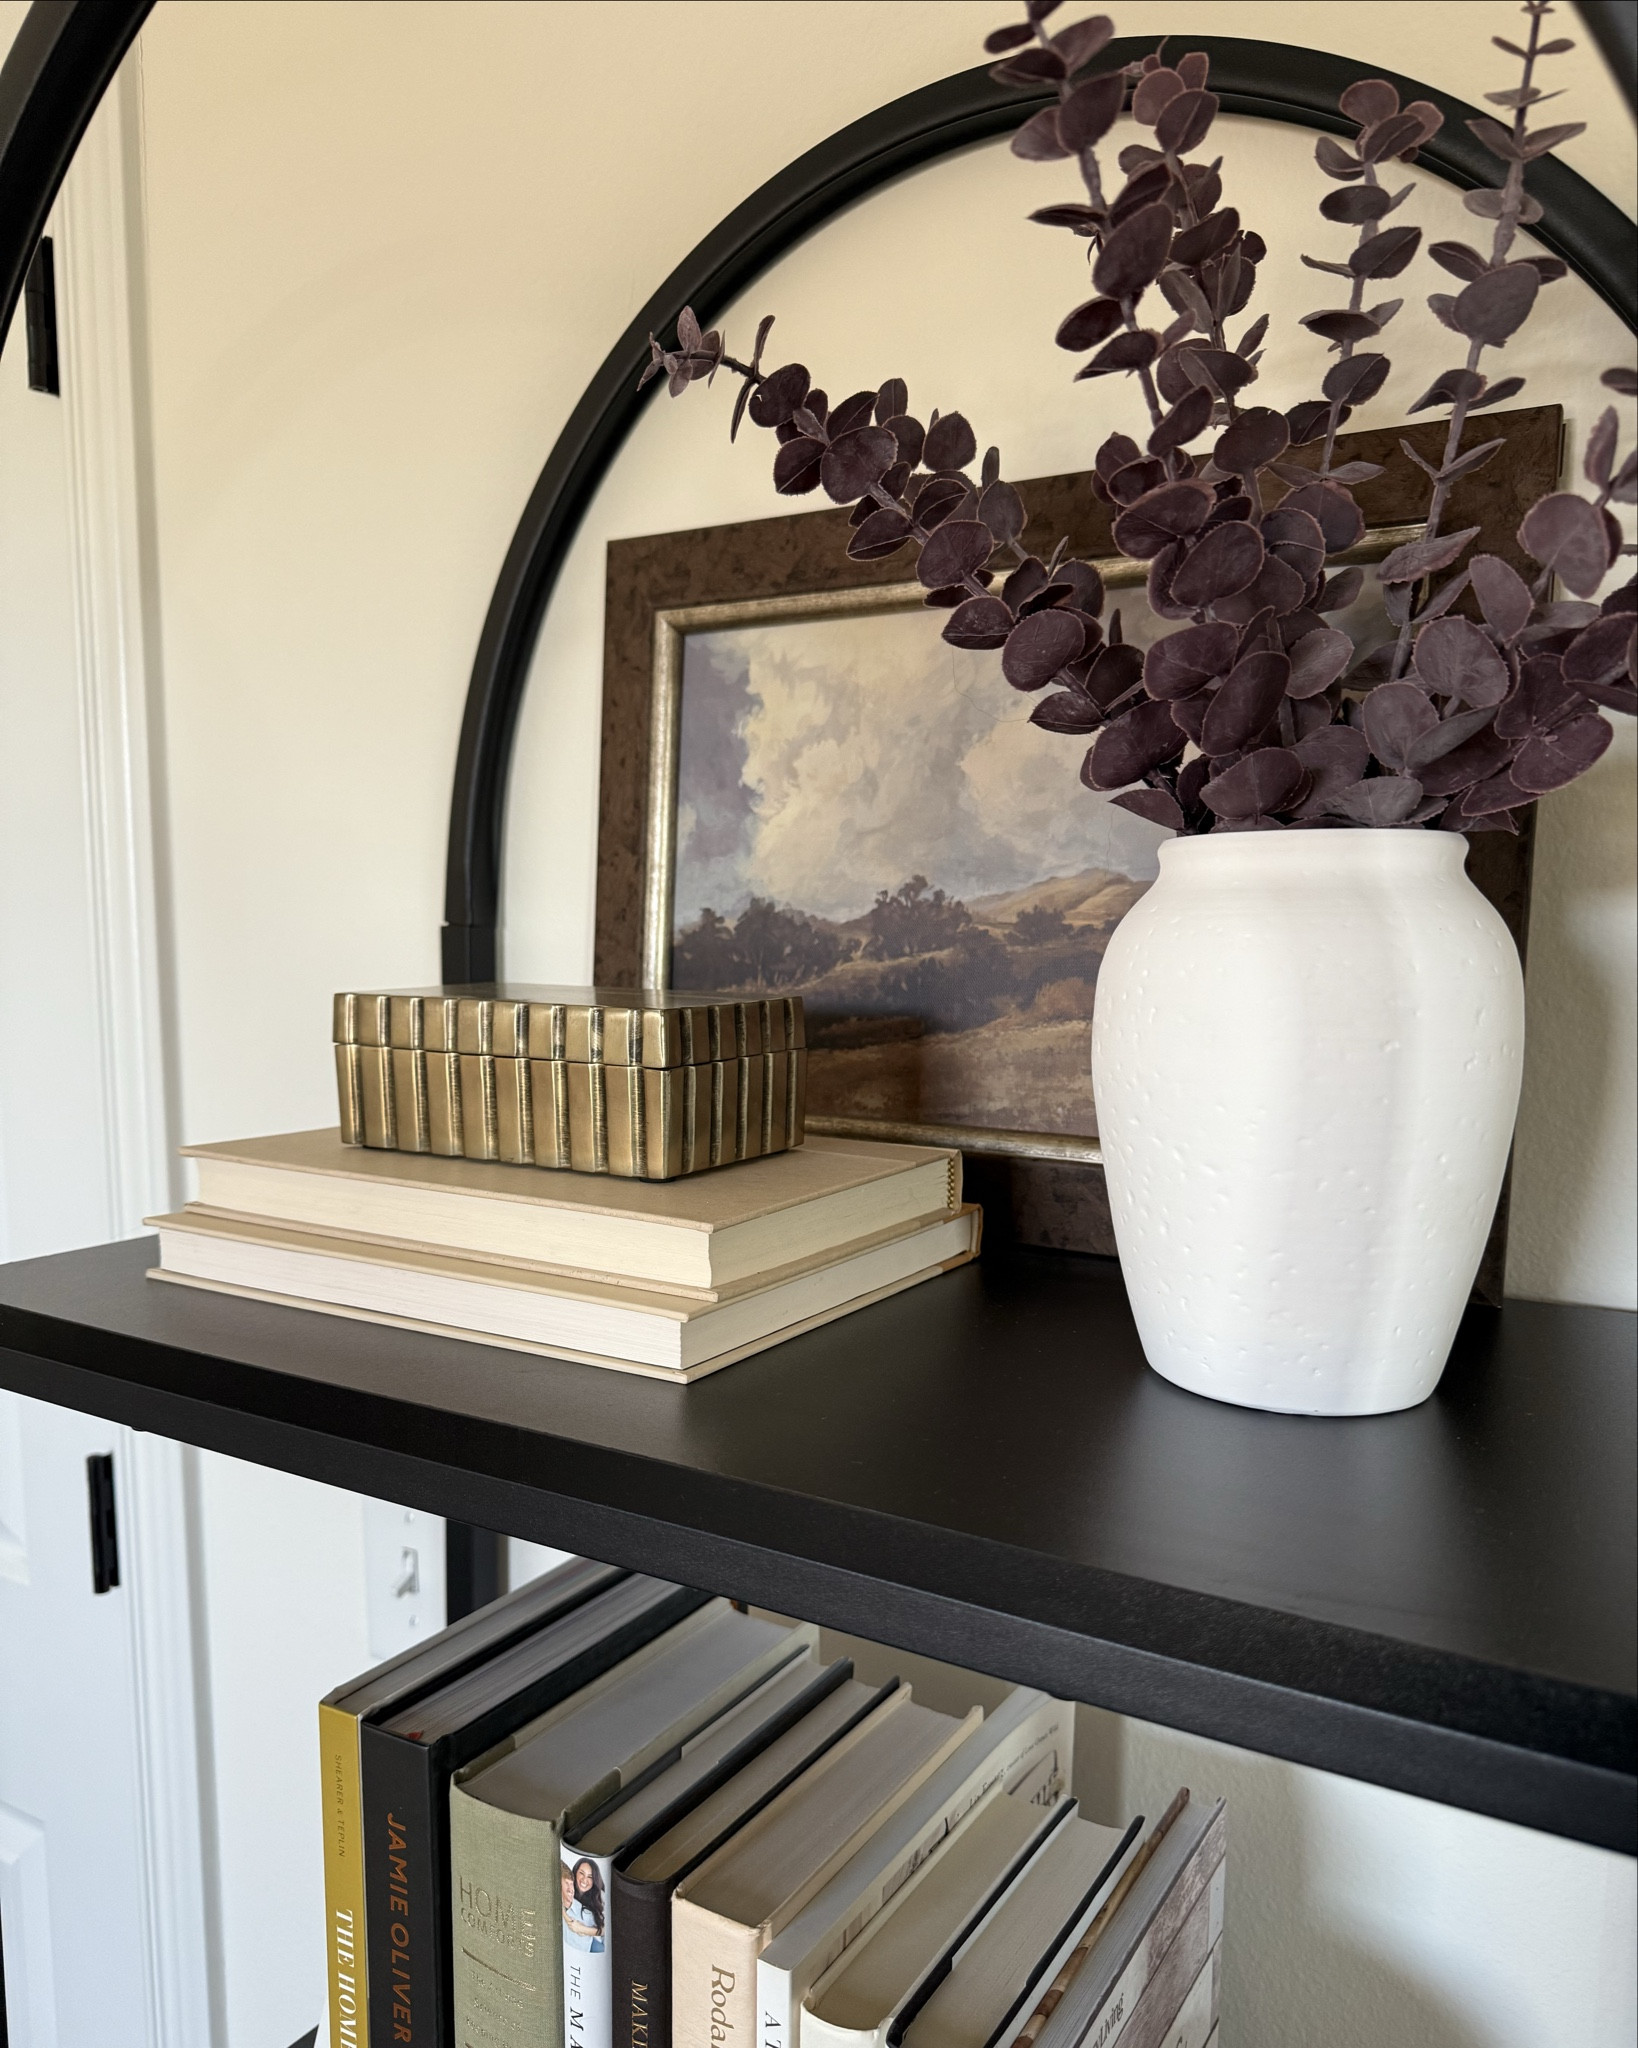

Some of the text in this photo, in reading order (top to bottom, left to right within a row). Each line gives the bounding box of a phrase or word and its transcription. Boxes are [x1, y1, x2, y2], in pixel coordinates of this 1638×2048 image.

[335, 1754, 344, 1805] SHEARER
[338, 1820, 346, 1857] TEPLIN
[336, 1908, 355, 1969] THE
[387, 1812, 412, 2043] JAMIE OLIVER
[570, 1965, 581, 2000] THE
[764, 2010, 782, 2028] A
